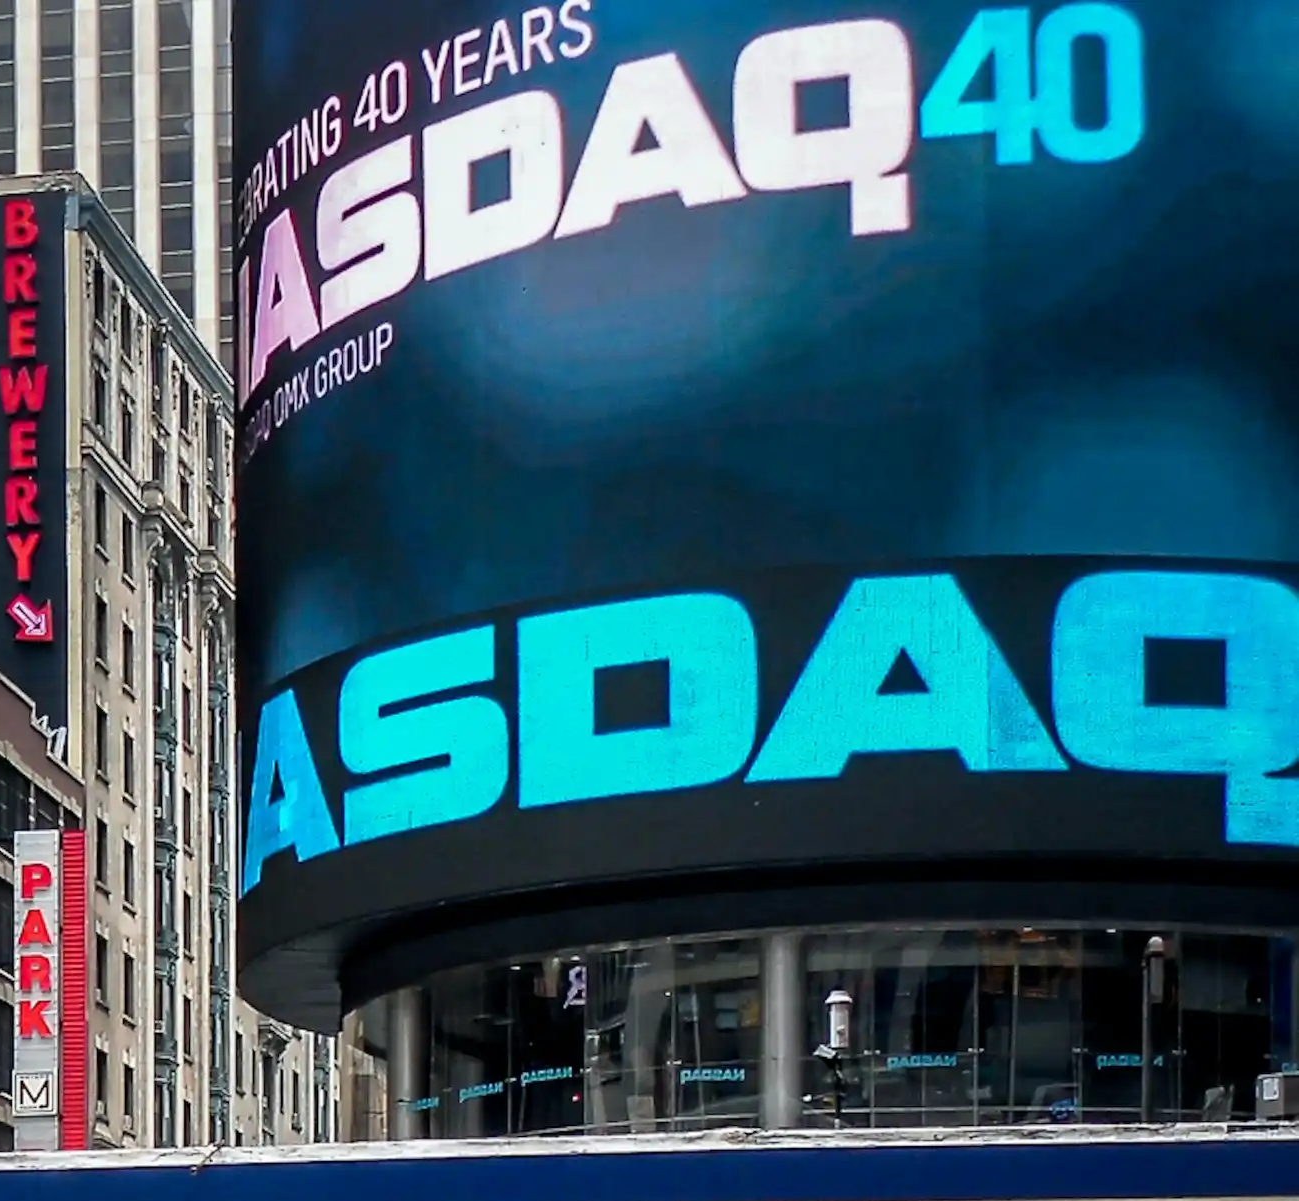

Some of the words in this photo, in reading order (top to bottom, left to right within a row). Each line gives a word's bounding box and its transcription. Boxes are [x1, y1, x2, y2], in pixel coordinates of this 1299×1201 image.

[353, 61, 408, 132] 40
[421, 0, 594, 104] YEARS
[919, 2, 1145, 166] 40
[273, 367, 310, 428] OMX
[313, 321, 393, 398] GROUP
[18, 862, 53, 1039] PARK
